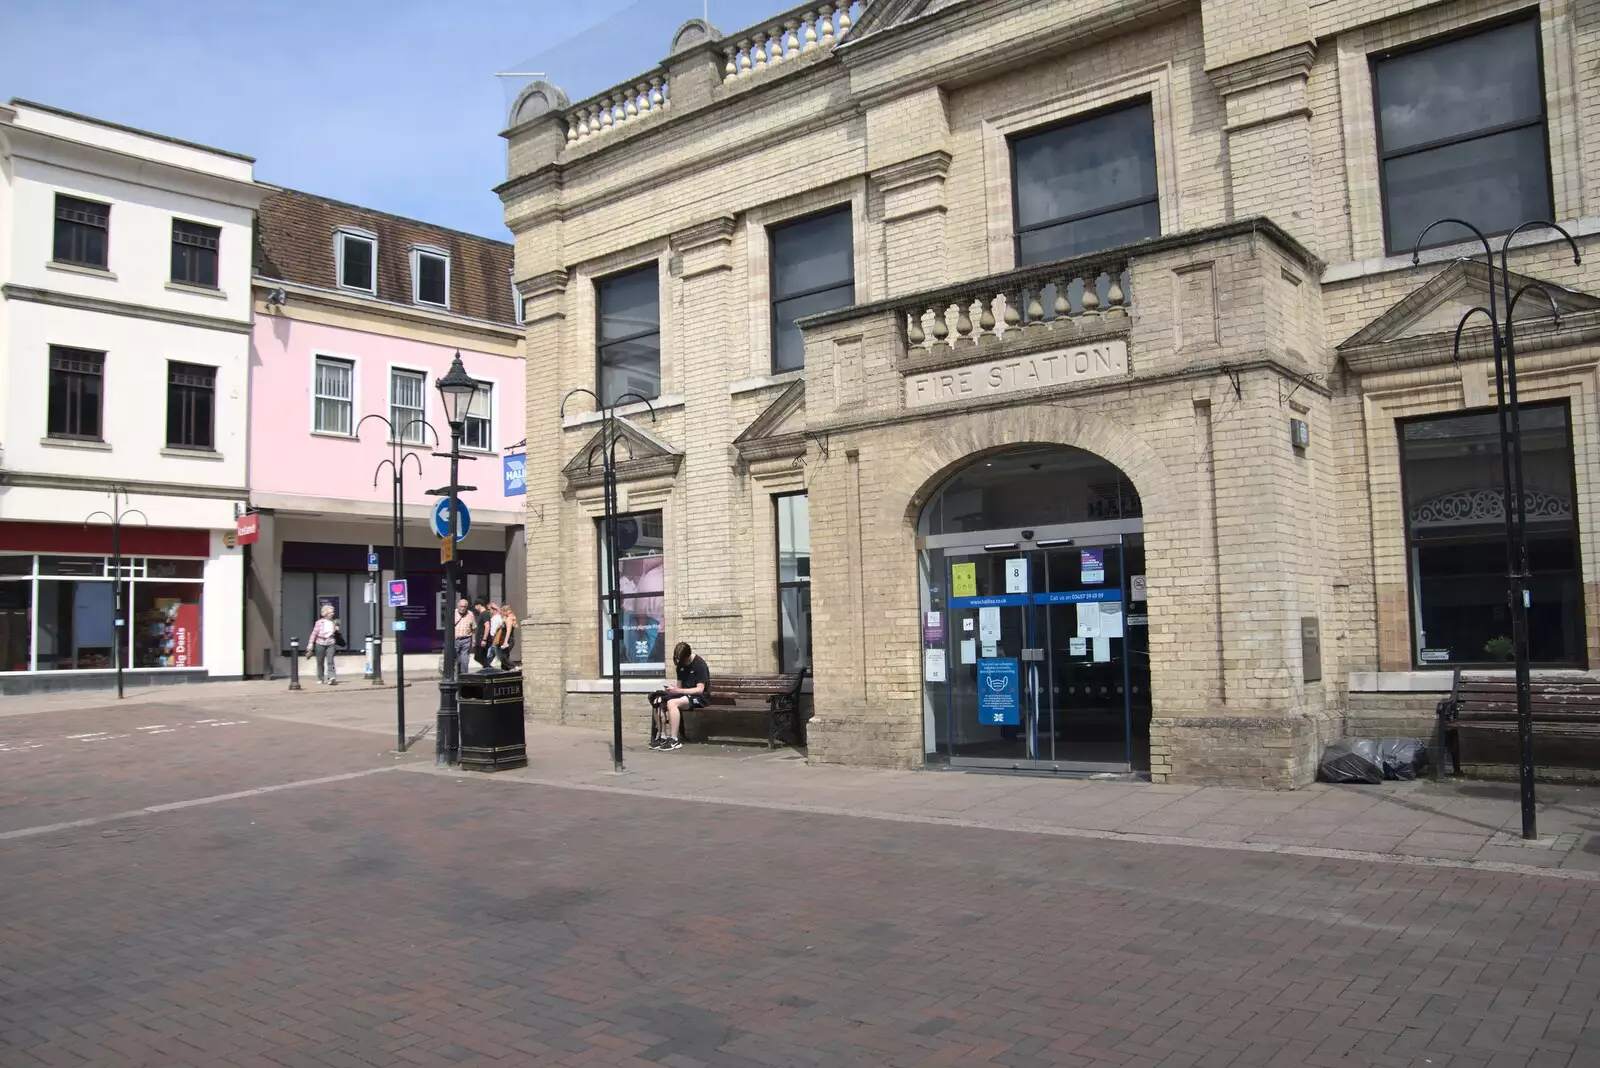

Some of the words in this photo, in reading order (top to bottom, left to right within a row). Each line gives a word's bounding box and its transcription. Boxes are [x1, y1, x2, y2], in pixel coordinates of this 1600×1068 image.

[915, 371, 973, 401] FIRE
[987, 346, 1122, 389] STATION.
[370, 555, 376, 563] P
[1013, 568, 1020, 577] 8
[176, 627, 185, 652] Deals
[493, 685, 520, 696] LITTER
